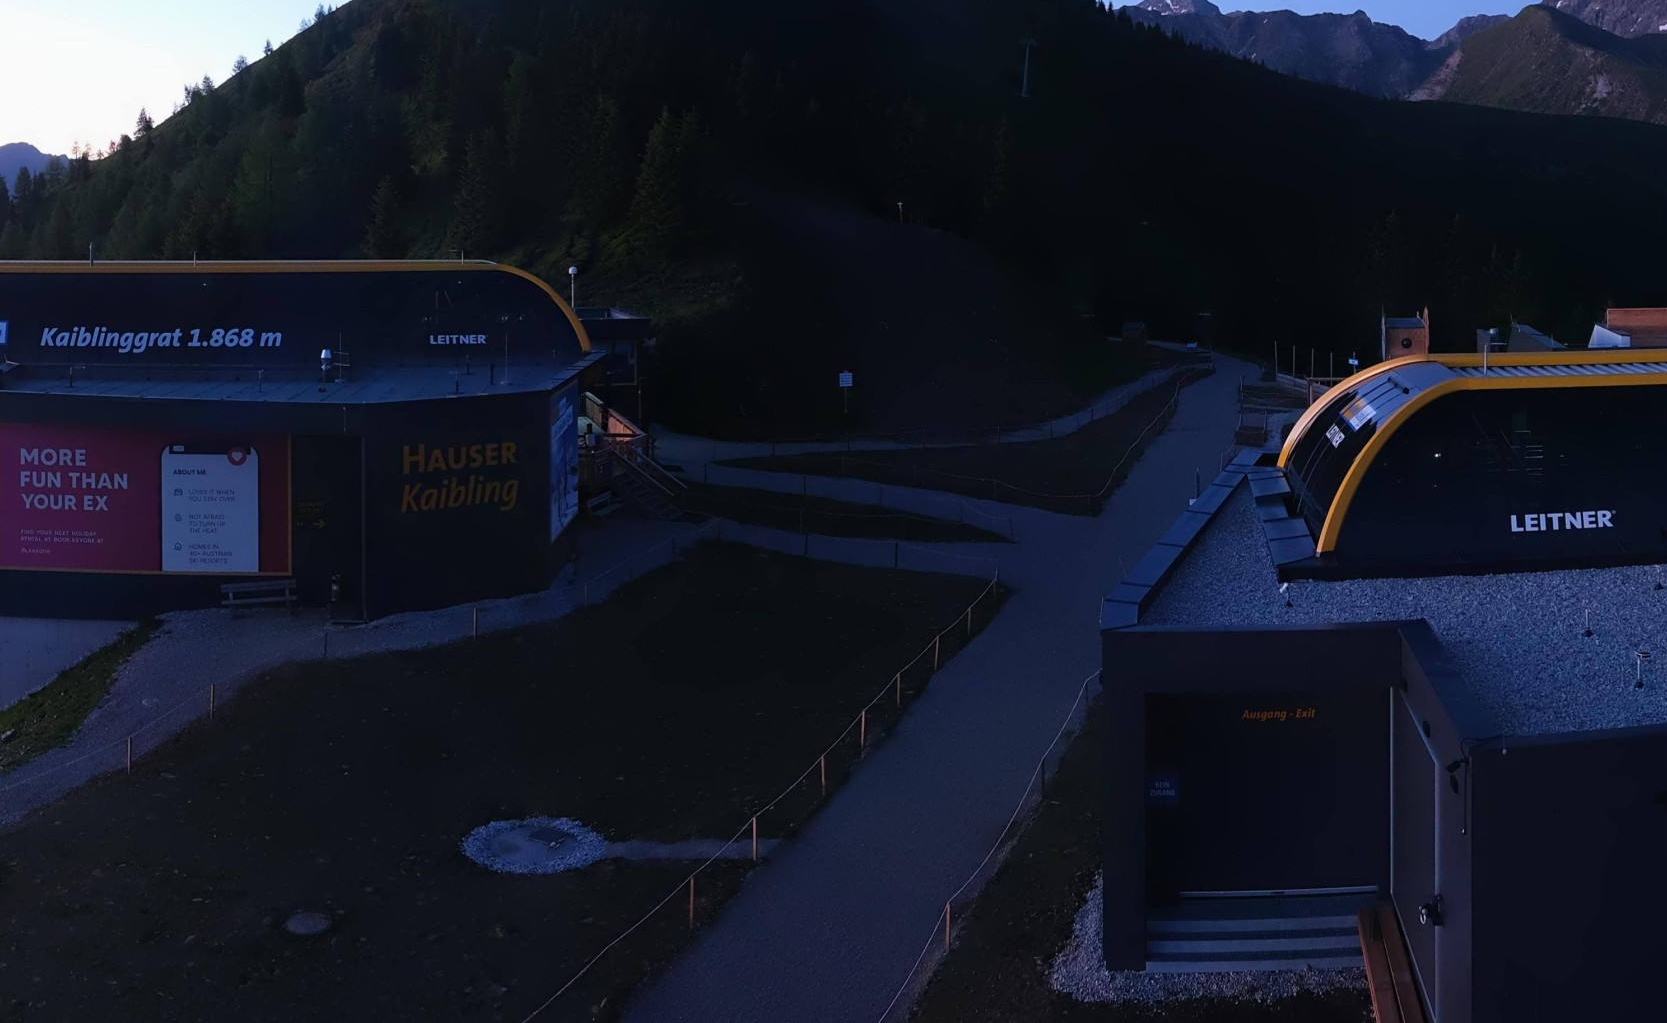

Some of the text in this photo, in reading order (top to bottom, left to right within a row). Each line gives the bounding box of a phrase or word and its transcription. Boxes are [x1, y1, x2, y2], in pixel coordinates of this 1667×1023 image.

[40, 326, 282, 353] Kaiblinggrat 1.868 m
[429, 334, 487, 345] LEITNER
[20, 448, 87, 466] MORE
[402, 441, 518, 475] HAUSER
[20, 471, 128, 490] FUN THAN
[21, 493, 108, 511] YOUR EX
[401, 475, 519, 514] Kaibling
[1510, 510, 1614, 532] LEITNER
[1241, 708, 1287, 722] Ausgang
[1296, 708, 1315, 719] Exit
